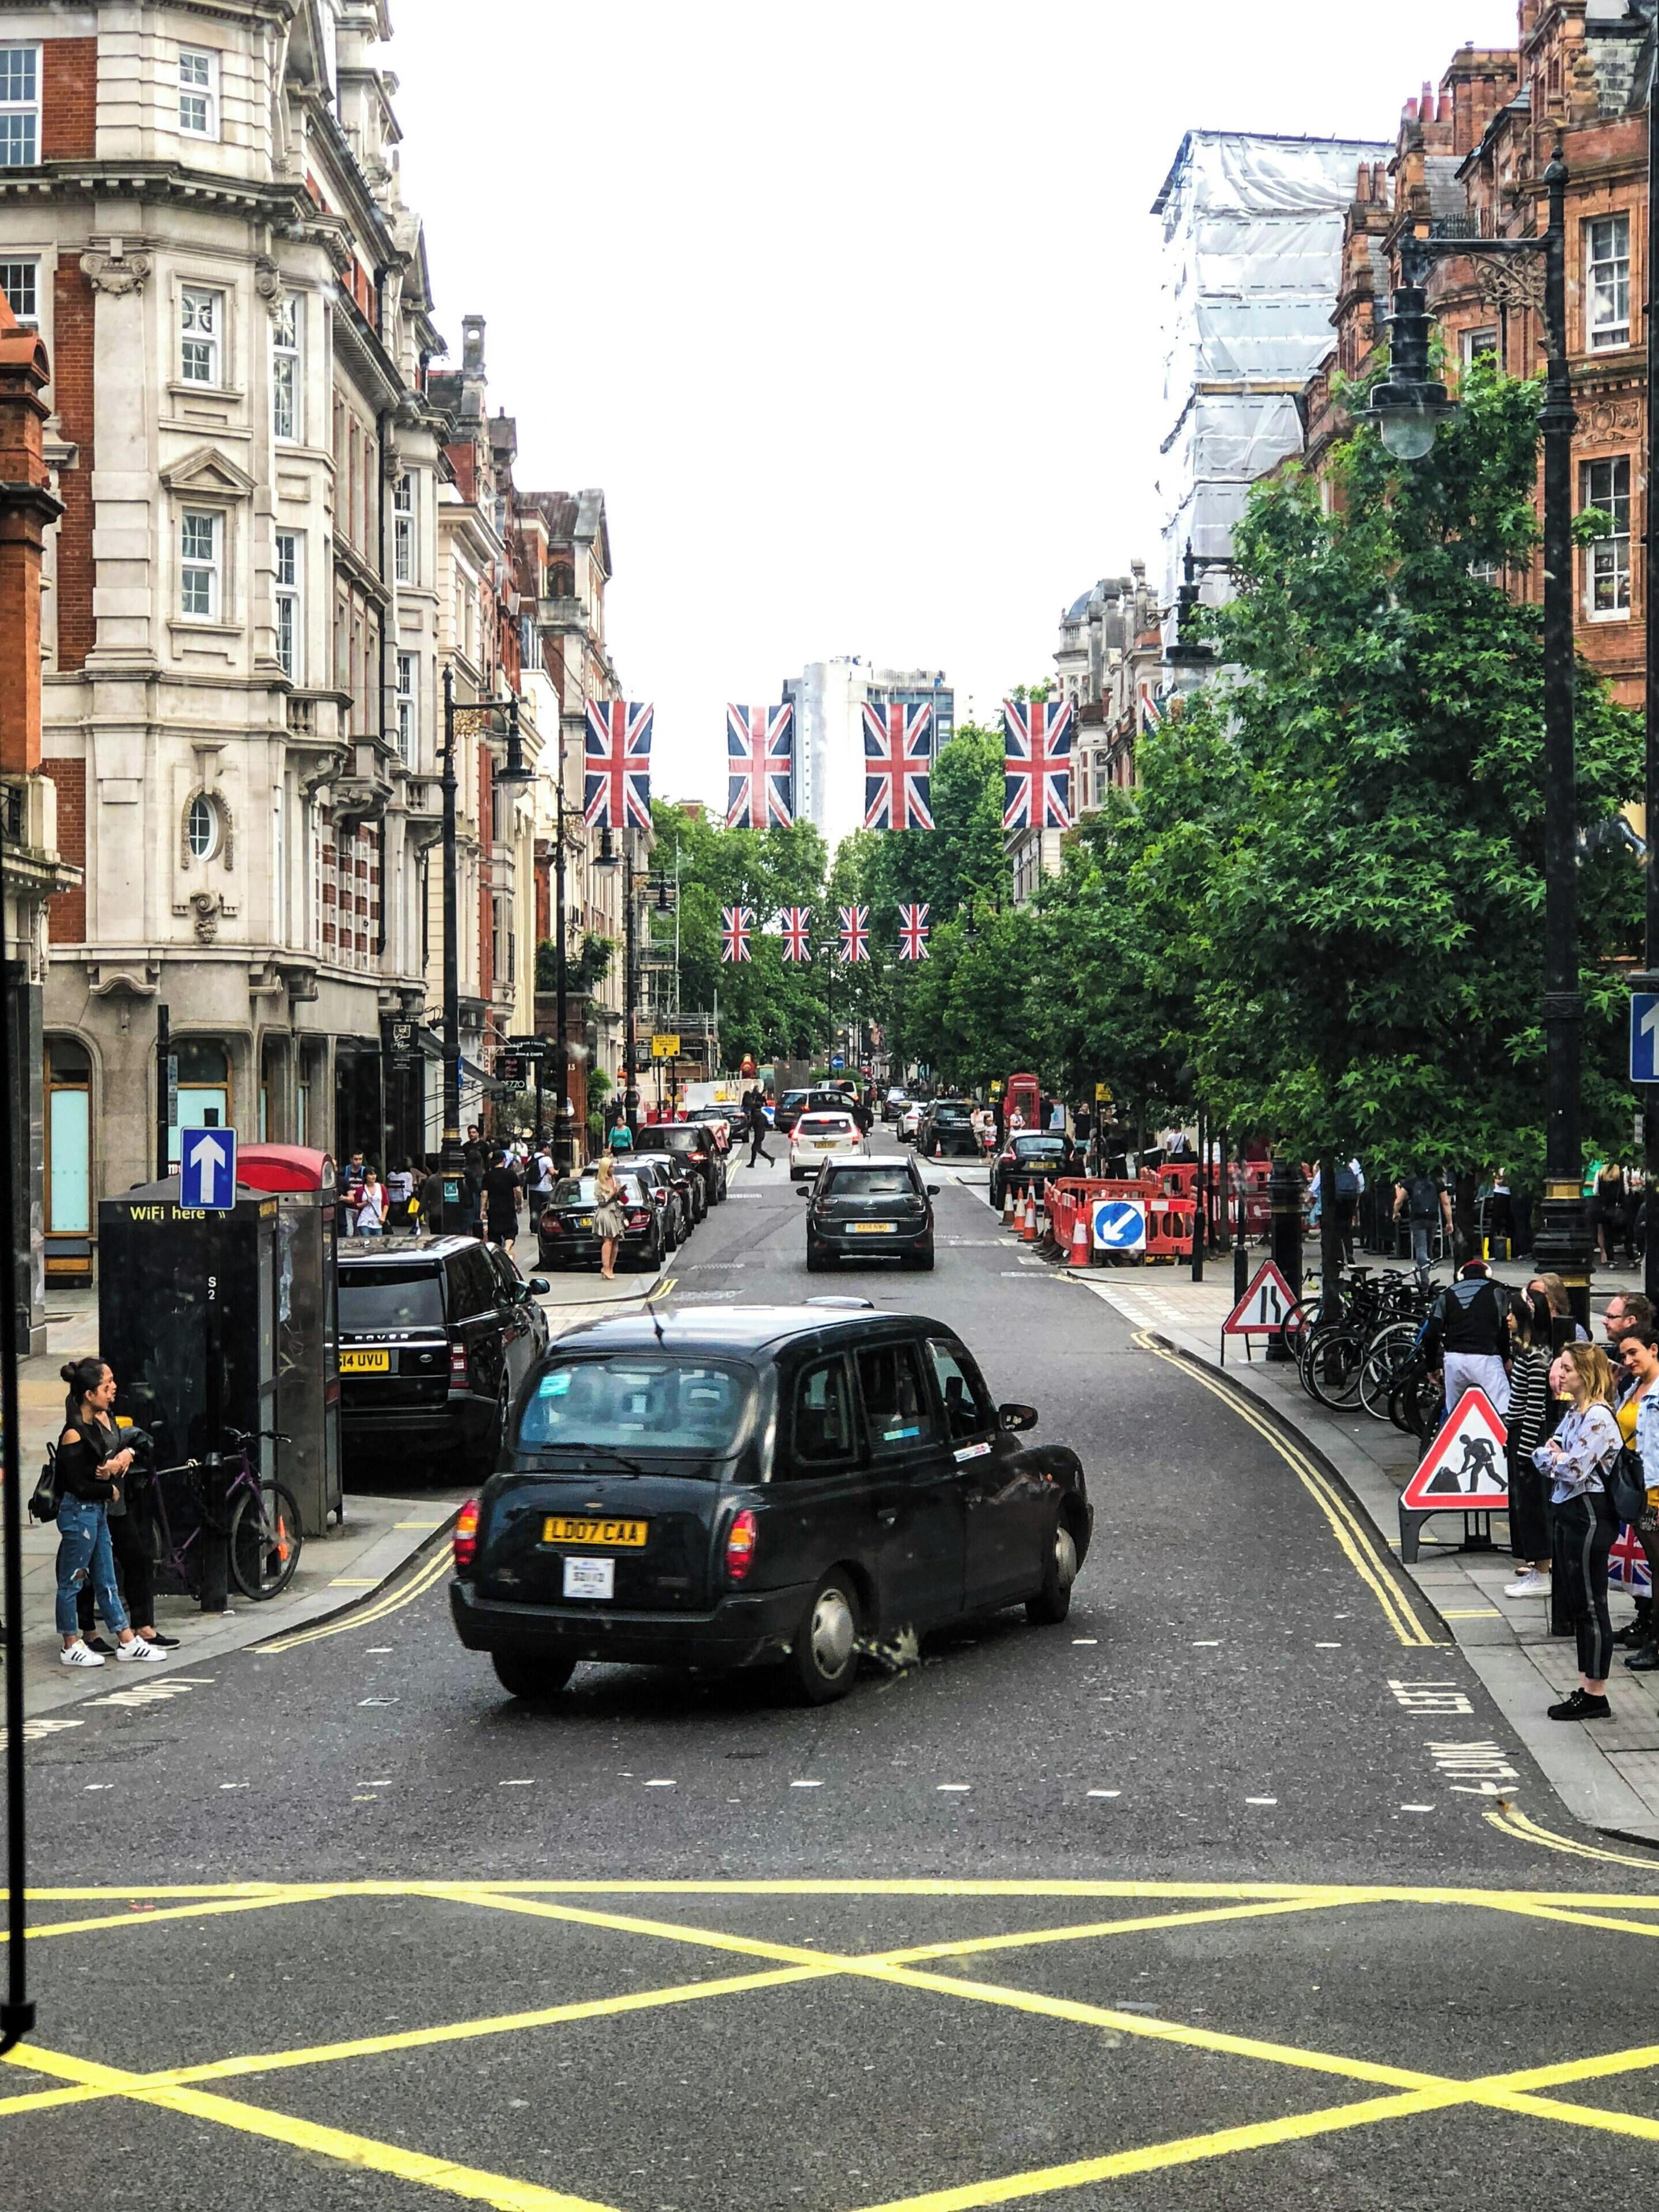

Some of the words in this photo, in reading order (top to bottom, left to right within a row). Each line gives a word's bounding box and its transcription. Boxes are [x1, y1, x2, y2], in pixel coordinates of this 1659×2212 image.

[130, 1206, 164, 1220] WiFi
[172, 1206, 206, 1219] here
[208, 1277, 217, 1287] S
[208, 1289, 215, 1300] 2
[355, 1334, 408, 1342] ROVER
[358, 1354, 382, 1366] UVU
[603, 1522, 638, 1542] CAA
[1387, 1680, 1475, 1714] LEFT
[1423, 1741, 1521, 1777] LOOK
